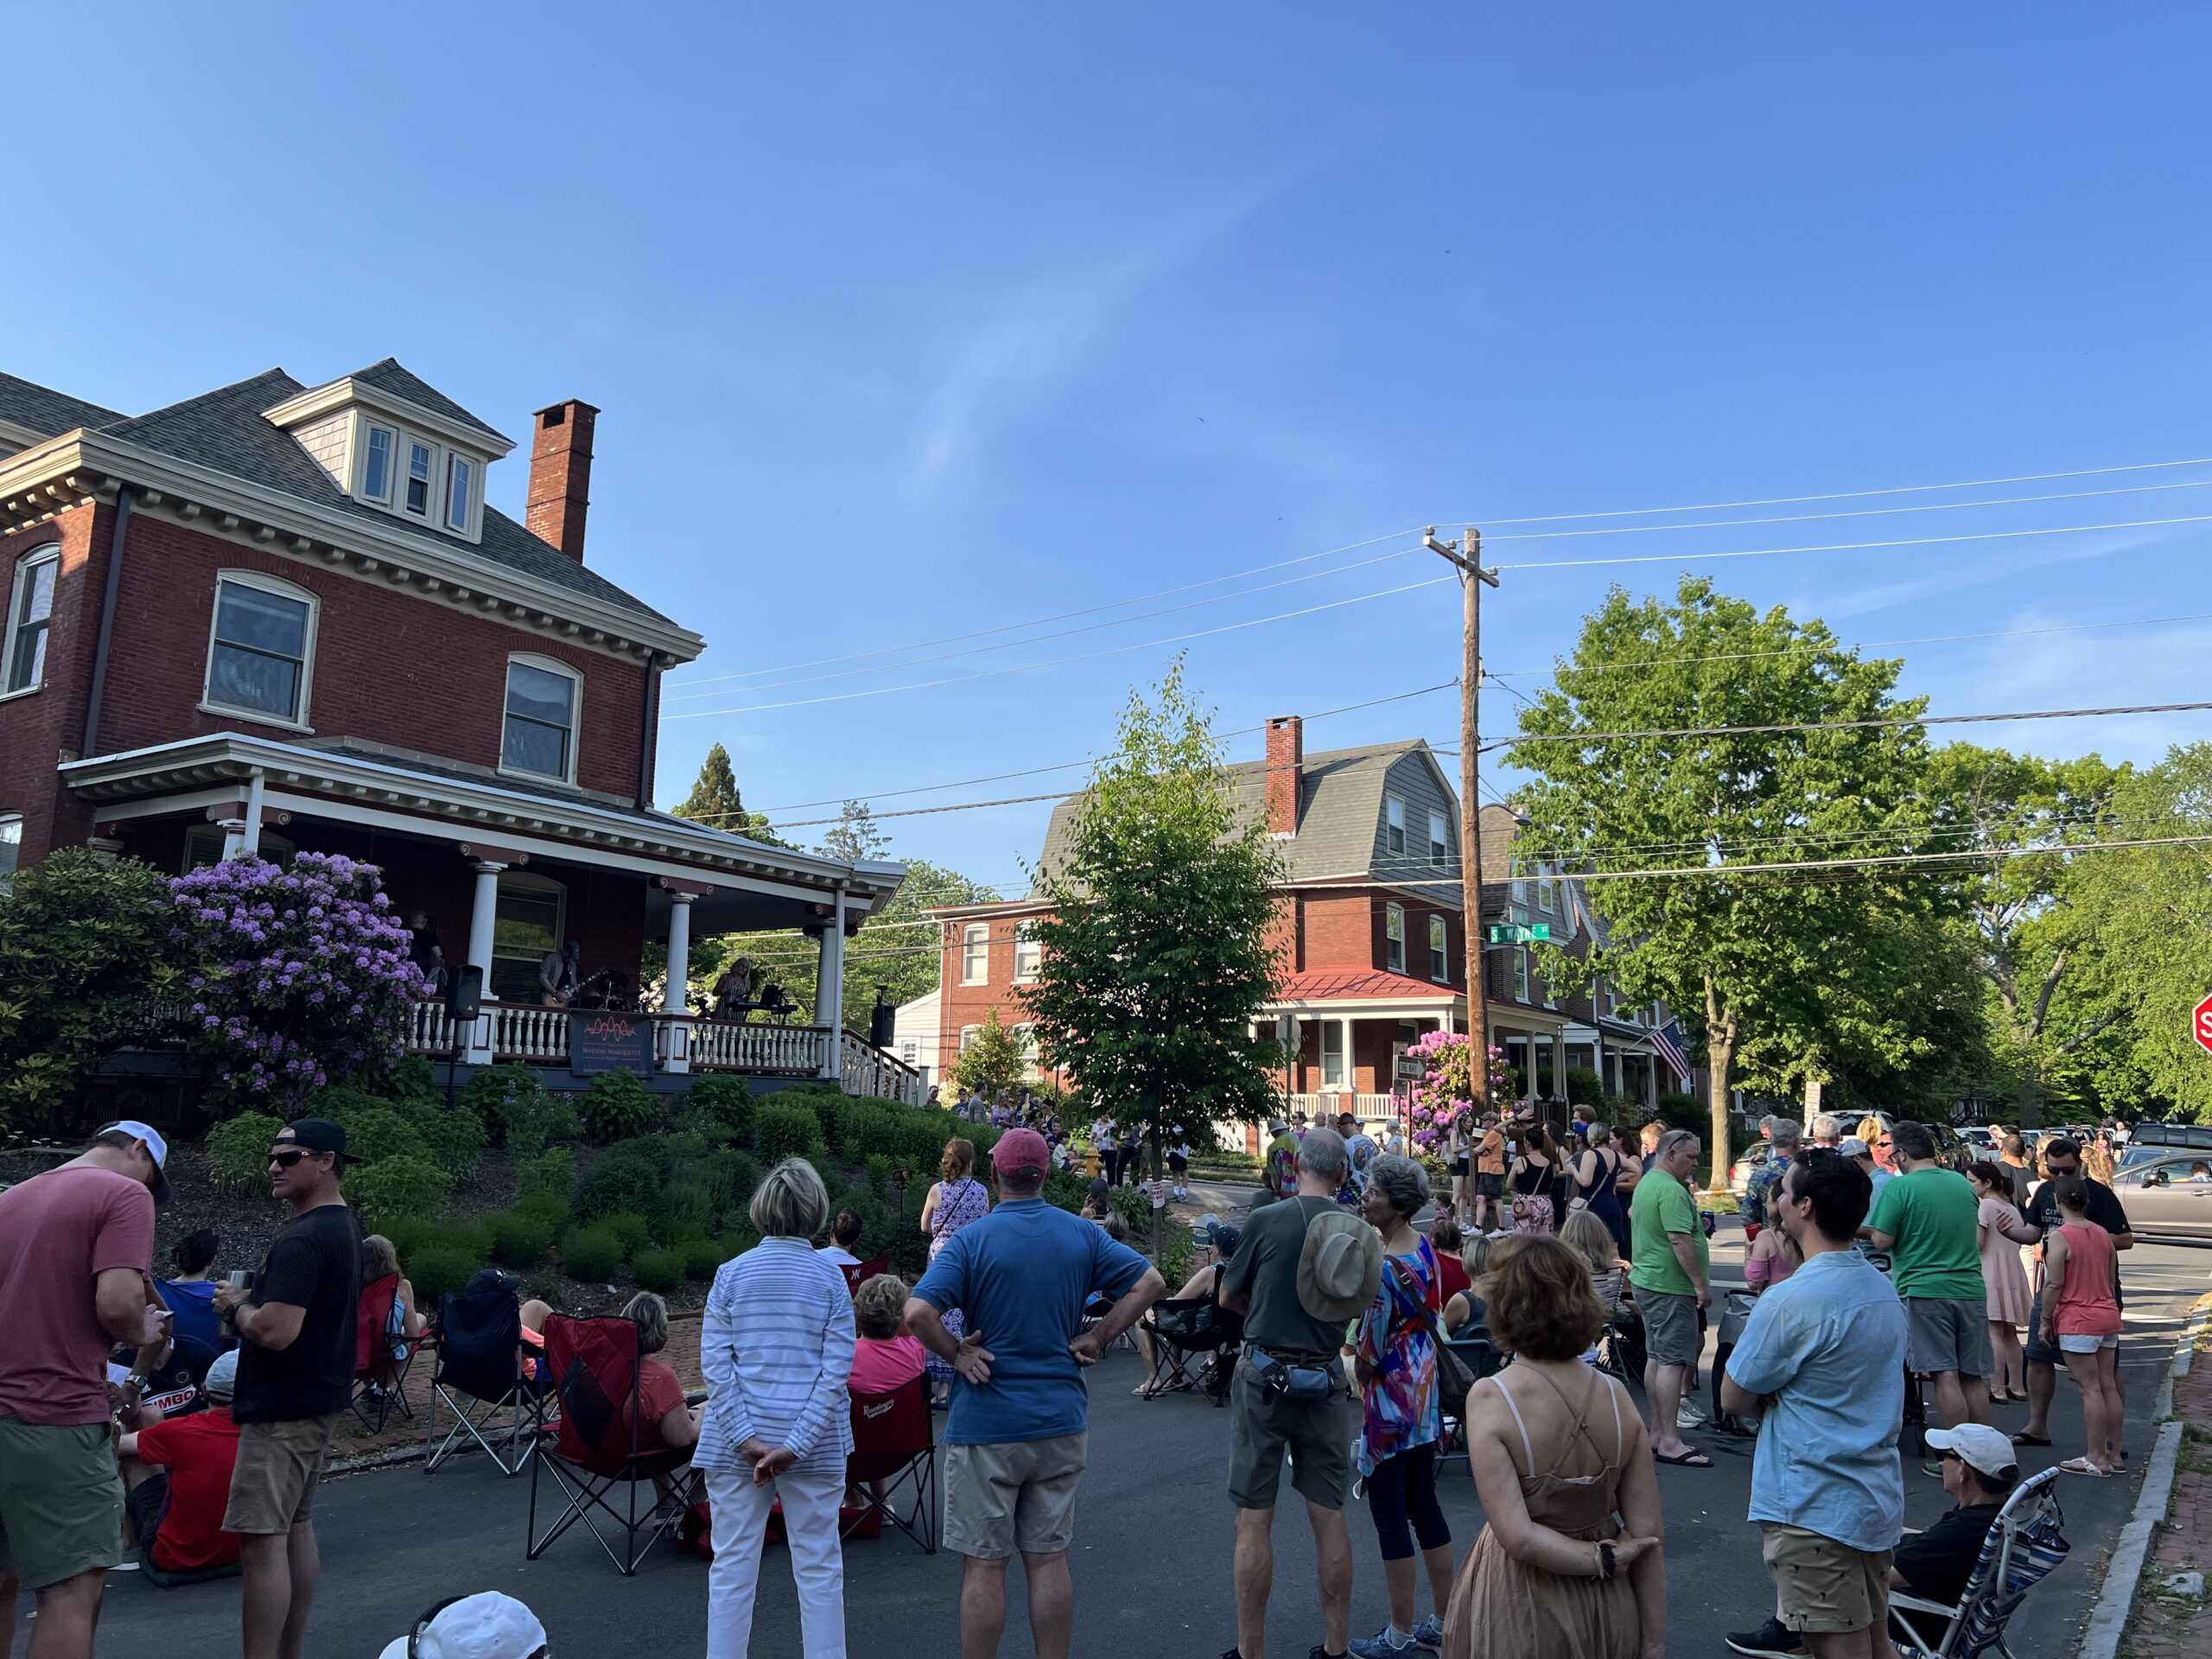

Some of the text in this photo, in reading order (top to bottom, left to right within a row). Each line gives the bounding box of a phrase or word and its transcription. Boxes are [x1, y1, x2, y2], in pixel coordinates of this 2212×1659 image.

[1506, 926, 1536, 940] WAYNE
[1400, 1063, 1418, 1074] ONE WAY
[2045, 1208, 2060, 1217] CIT
